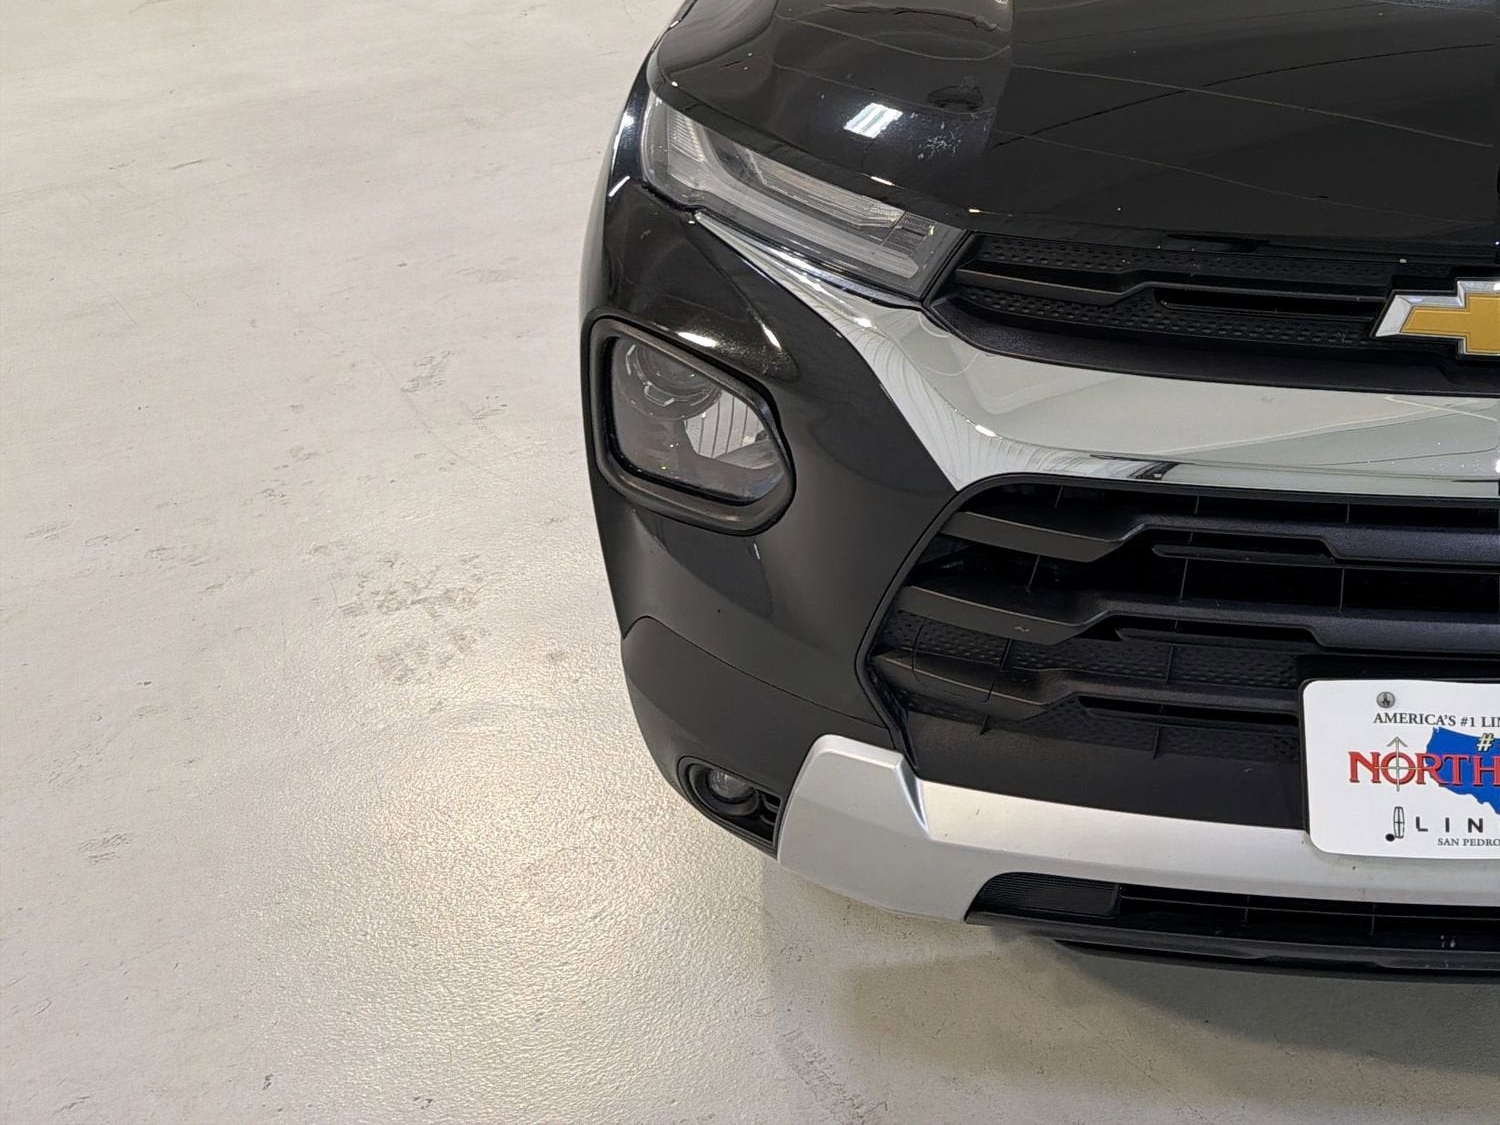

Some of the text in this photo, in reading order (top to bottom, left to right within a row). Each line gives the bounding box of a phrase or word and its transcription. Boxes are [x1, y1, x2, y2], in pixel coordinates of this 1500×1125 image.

[1372, 712, 1457, 726] AMERICA'S
[1460, 716, 1477, 728] #1
[1437, 837, 1460, 847] SAN
